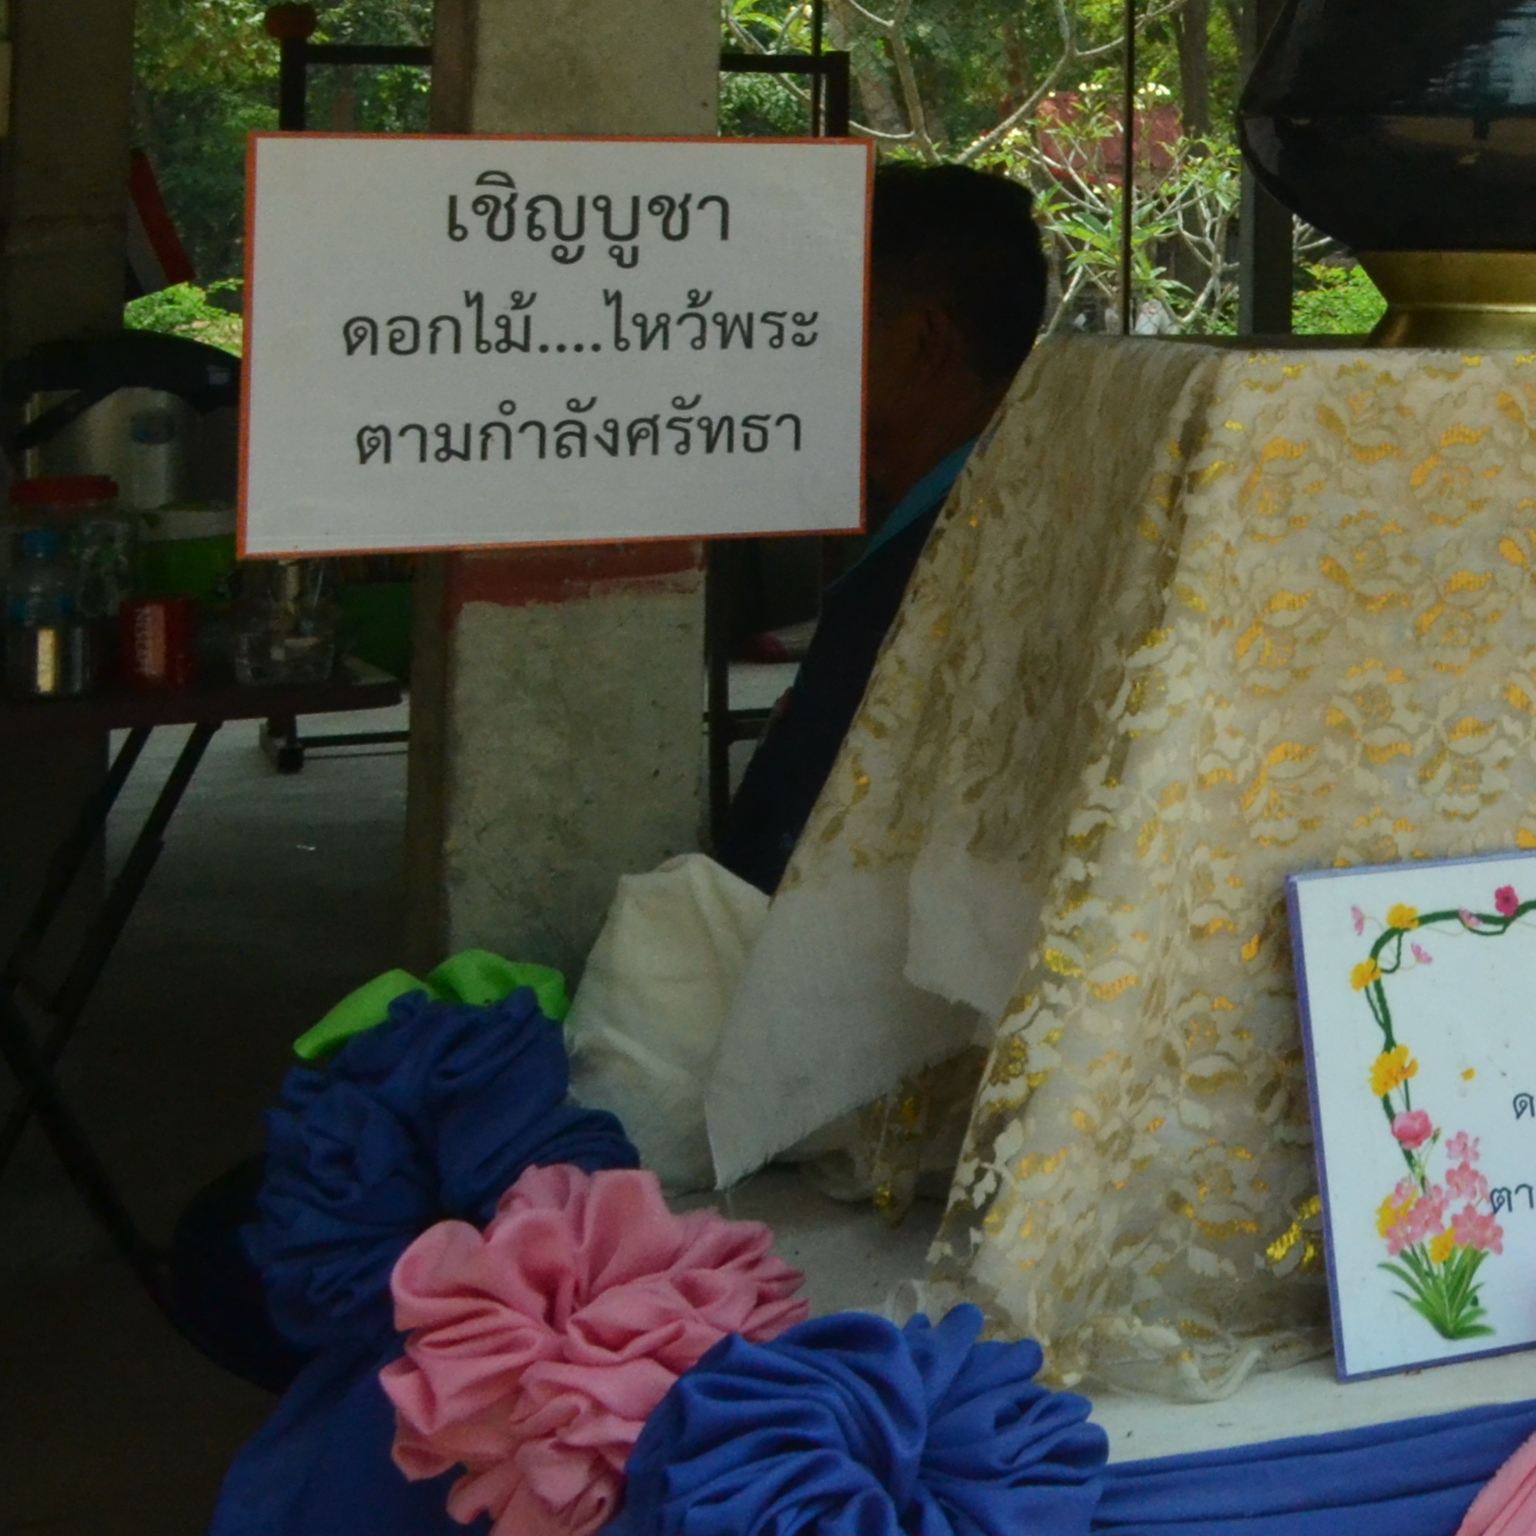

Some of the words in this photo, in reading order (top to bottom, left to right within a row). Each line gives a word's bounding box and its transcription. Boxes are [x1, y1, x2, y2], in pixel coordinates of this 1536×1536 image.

[448, 170, 730, 268] เชิญบูชา
[355, 394, 802, 465] ตามกำลังศรัทธา
